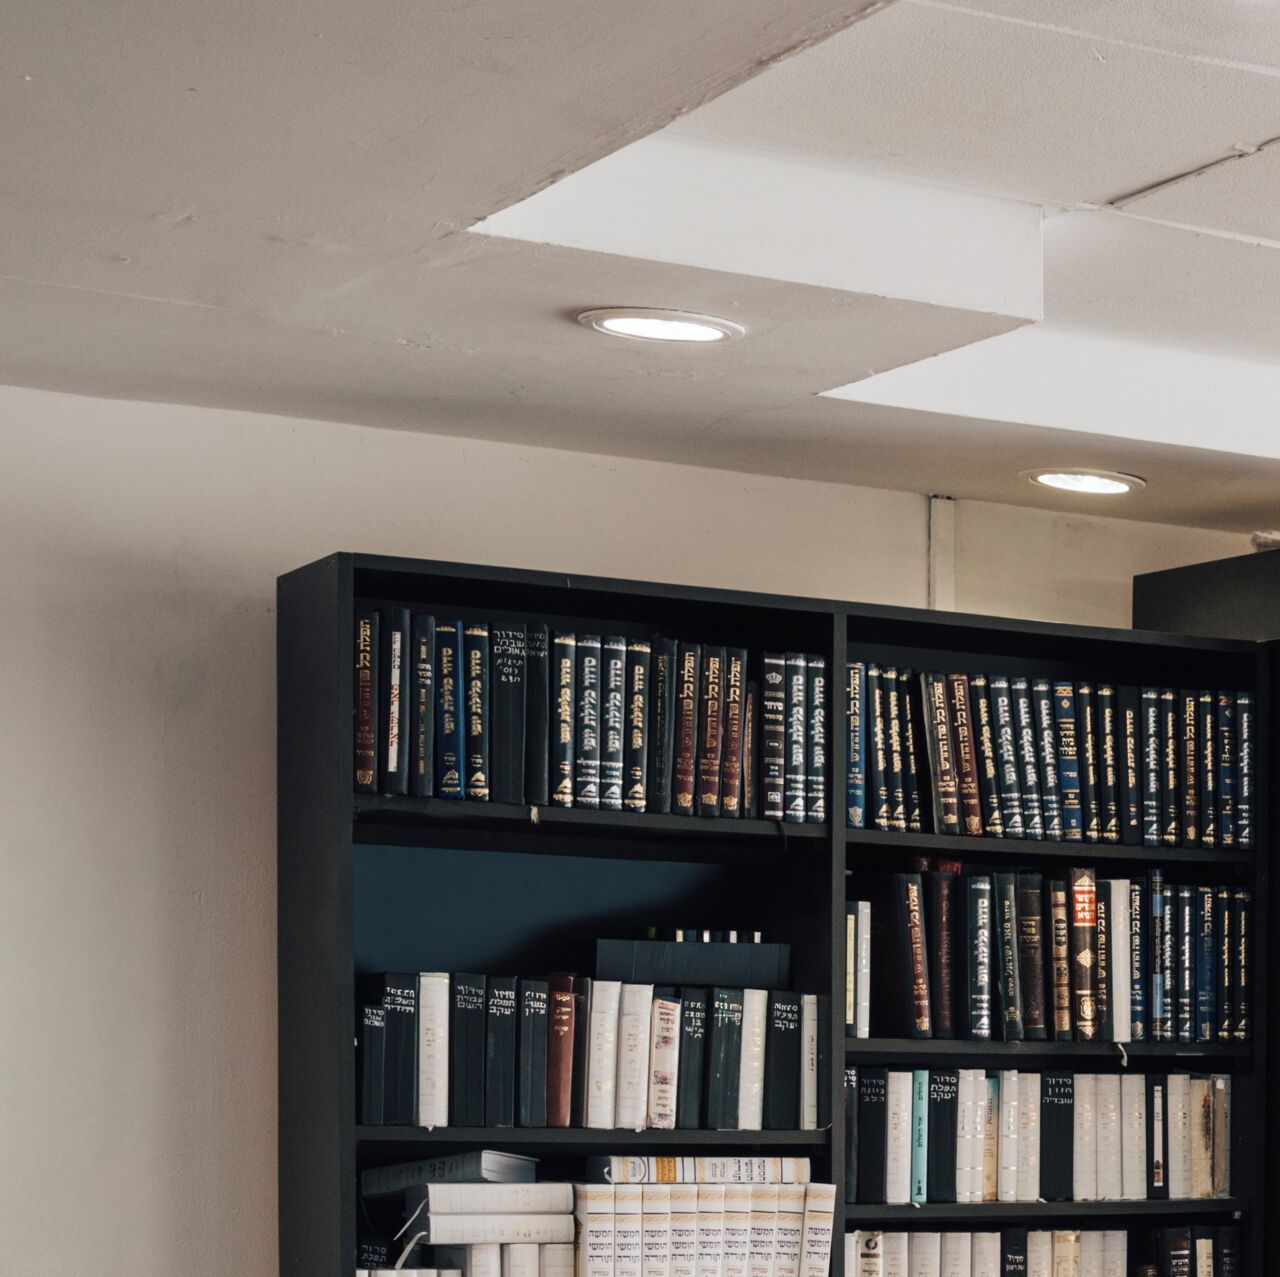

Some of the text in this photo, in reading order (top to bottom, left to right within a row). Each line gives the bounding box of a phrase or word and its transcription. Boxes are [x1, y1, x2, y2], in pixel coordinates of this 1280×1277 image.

[357, 619, 370, 651] תפלת
[493, 630, 524, 639] סידור
[356, 652, 371, 668] כל
[680, 652, 694, 681] תפלת
[584, 656, 597, 687] סדור
[679, 683, 693, 698] כל
[792, 675, 804, 705] סדור
[847, 669, 860, 699] תפלת
[704, 684, 718, 699] כל
[952, 681, 964, 710] תפלת
[847, 700, 859, 715] כל
[998, 697, 1008, 725] סדור
[1184, 697, 1195, 725] תפלת
[850, 716, 860, 731] פה
[933, 709, 945, 725] כל
[955, 711, 966, 726] כל
[1126, 710, 1134, 735] סדור
[938, 725, 947, 740] פה
[959, 727, 968, 742] פה
[1184, 725, 1195, 740] כל
[1130, 891, 1140, 919] תפלת
[977, 898, 988, 927] סדור
[1004, 922, 1012, 940] פאר
[1130, 920, 1140, 934] כל
[1004, 945, 1013, 976] ישראל
[489, 999, 515, 1007] תפלת
[489, 1006, 514, 1016] יעקב
[933, 1075, 957, 1083] סדור
[1046, 1077, 1072, 1085] סידור
[931, 1083, 956, 1092] תפלת
[1049, 1087, 1072, 1095] חזון
[930, 1092, 955, 1102] יעקב
[589, 1230, 612, 1238] חמשה
[644, 1230, 667, 1238] חמשה
[672, 1229, 695, 1237] חמשה
[751, 1228, 773, 1236] חמשה
[808, 1227, 831, 1235] חמשה
[589, 1242, 612, 1251] חומשי
[644, 1242, 667, 1251] חומשי
[672, 1241, 695, 1250] חומשי
[750, 1240, 773, 1248] חומשי
[806, 1239, 830, 1247] חומשי
[589, 1255, 612, 1263] תורה
[644, 1254, 667, 1263] תורה
[672, 1253, 695, 1262] תורה
[749, 1252, 772, 1261] תורה
[805, 1251, 829, 1259] תורה
